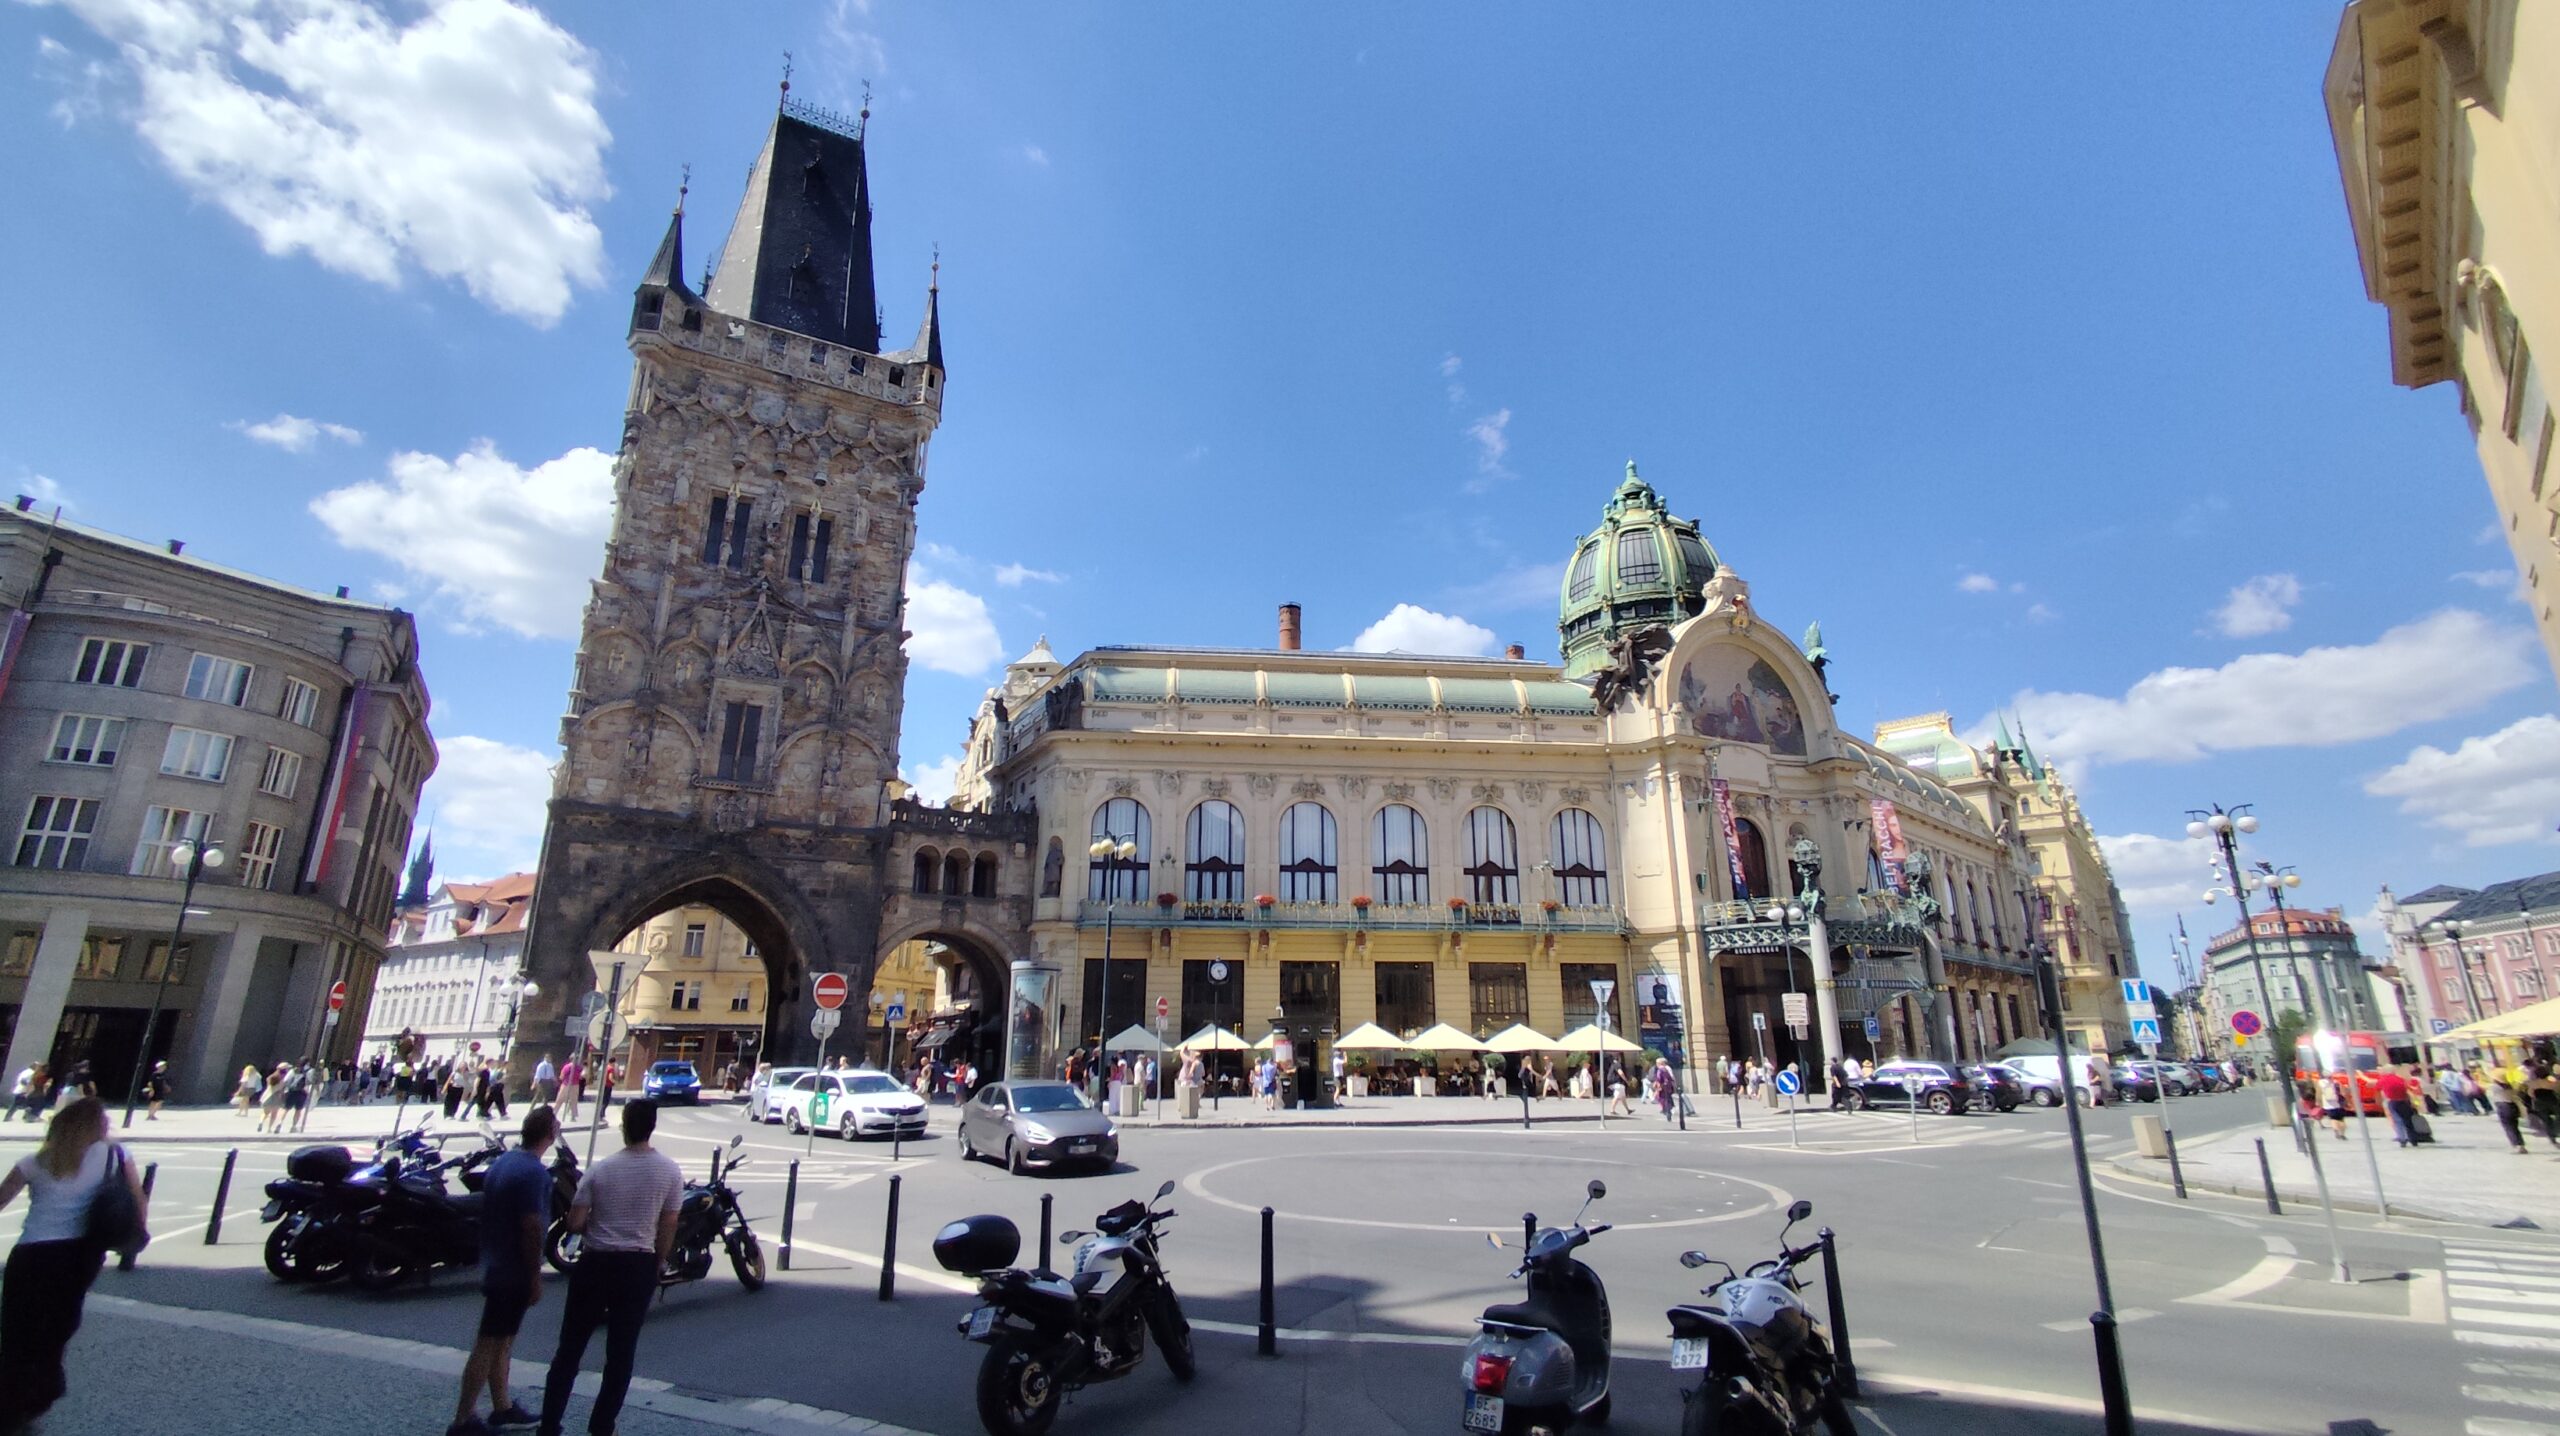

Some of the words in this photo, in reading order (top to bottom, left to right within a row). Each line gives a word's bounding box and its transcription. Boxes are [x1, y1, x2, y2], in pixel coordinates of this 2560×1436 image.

[1713, 787, 1744, 885] BELTRACCHI
[1872, 806, 1899, 894] BELTRACCHI
[1868, 1020, 1876, 1031] P
[2433, 1020, 2446, 1033] P
[1673, 1353, 1702, 1366] C972
[1466, 1411, 1497, 1428] 2685
